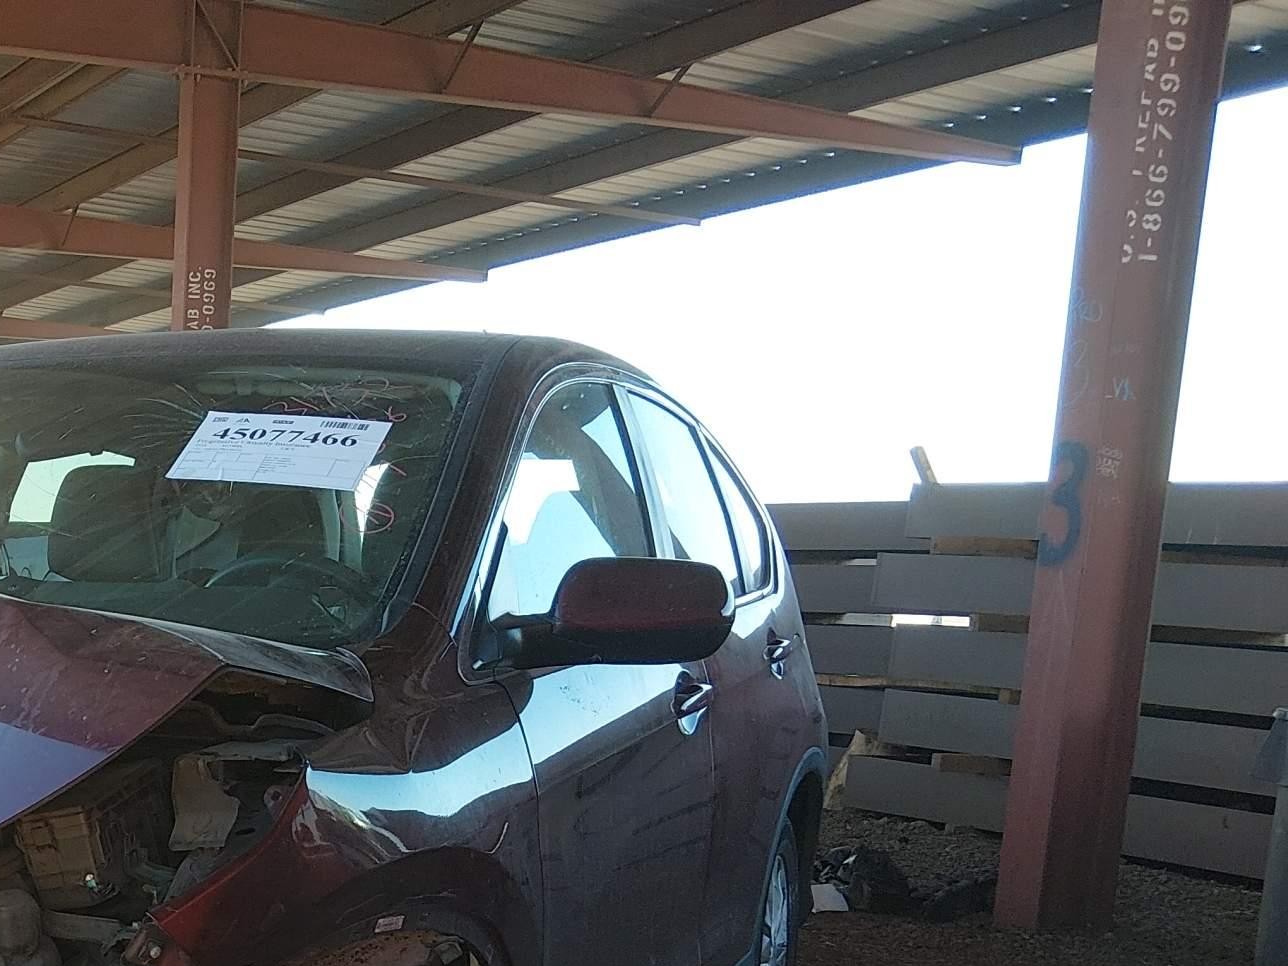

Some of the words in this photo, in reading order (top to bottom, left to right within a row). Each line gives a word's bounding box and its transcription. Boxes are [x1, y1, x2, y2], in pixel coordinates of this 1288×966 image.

[1138, 0, 1189, 260] 1-866-799-09
[188, 266, 201, 299] INC.
[212, 427, 360, 447] 45077466
[1039, 440, 1090, 567] 3
